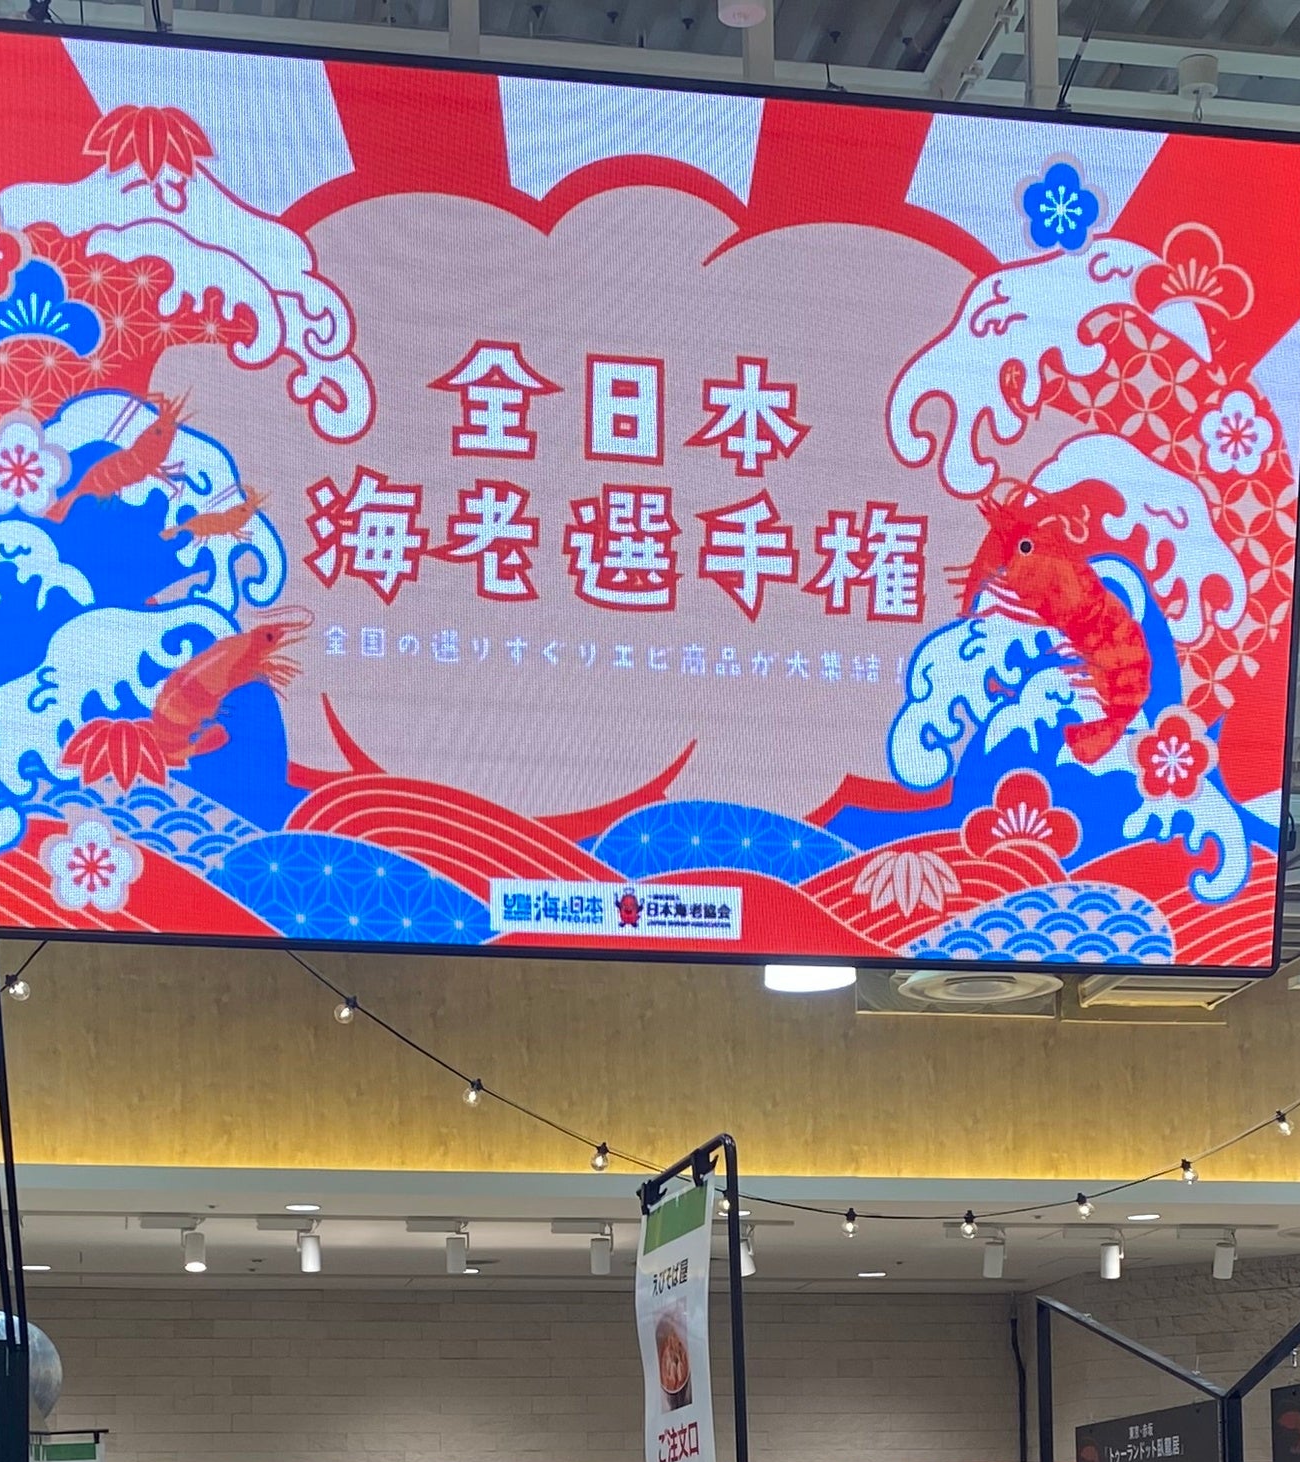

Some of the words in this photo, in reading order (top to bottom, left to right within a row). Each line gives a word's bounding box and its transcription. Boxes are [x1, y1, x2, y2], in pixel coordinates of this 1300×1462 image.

[428, 340, 811, 477] 全日本
[304, 464, 931, 623] 海老選手権
